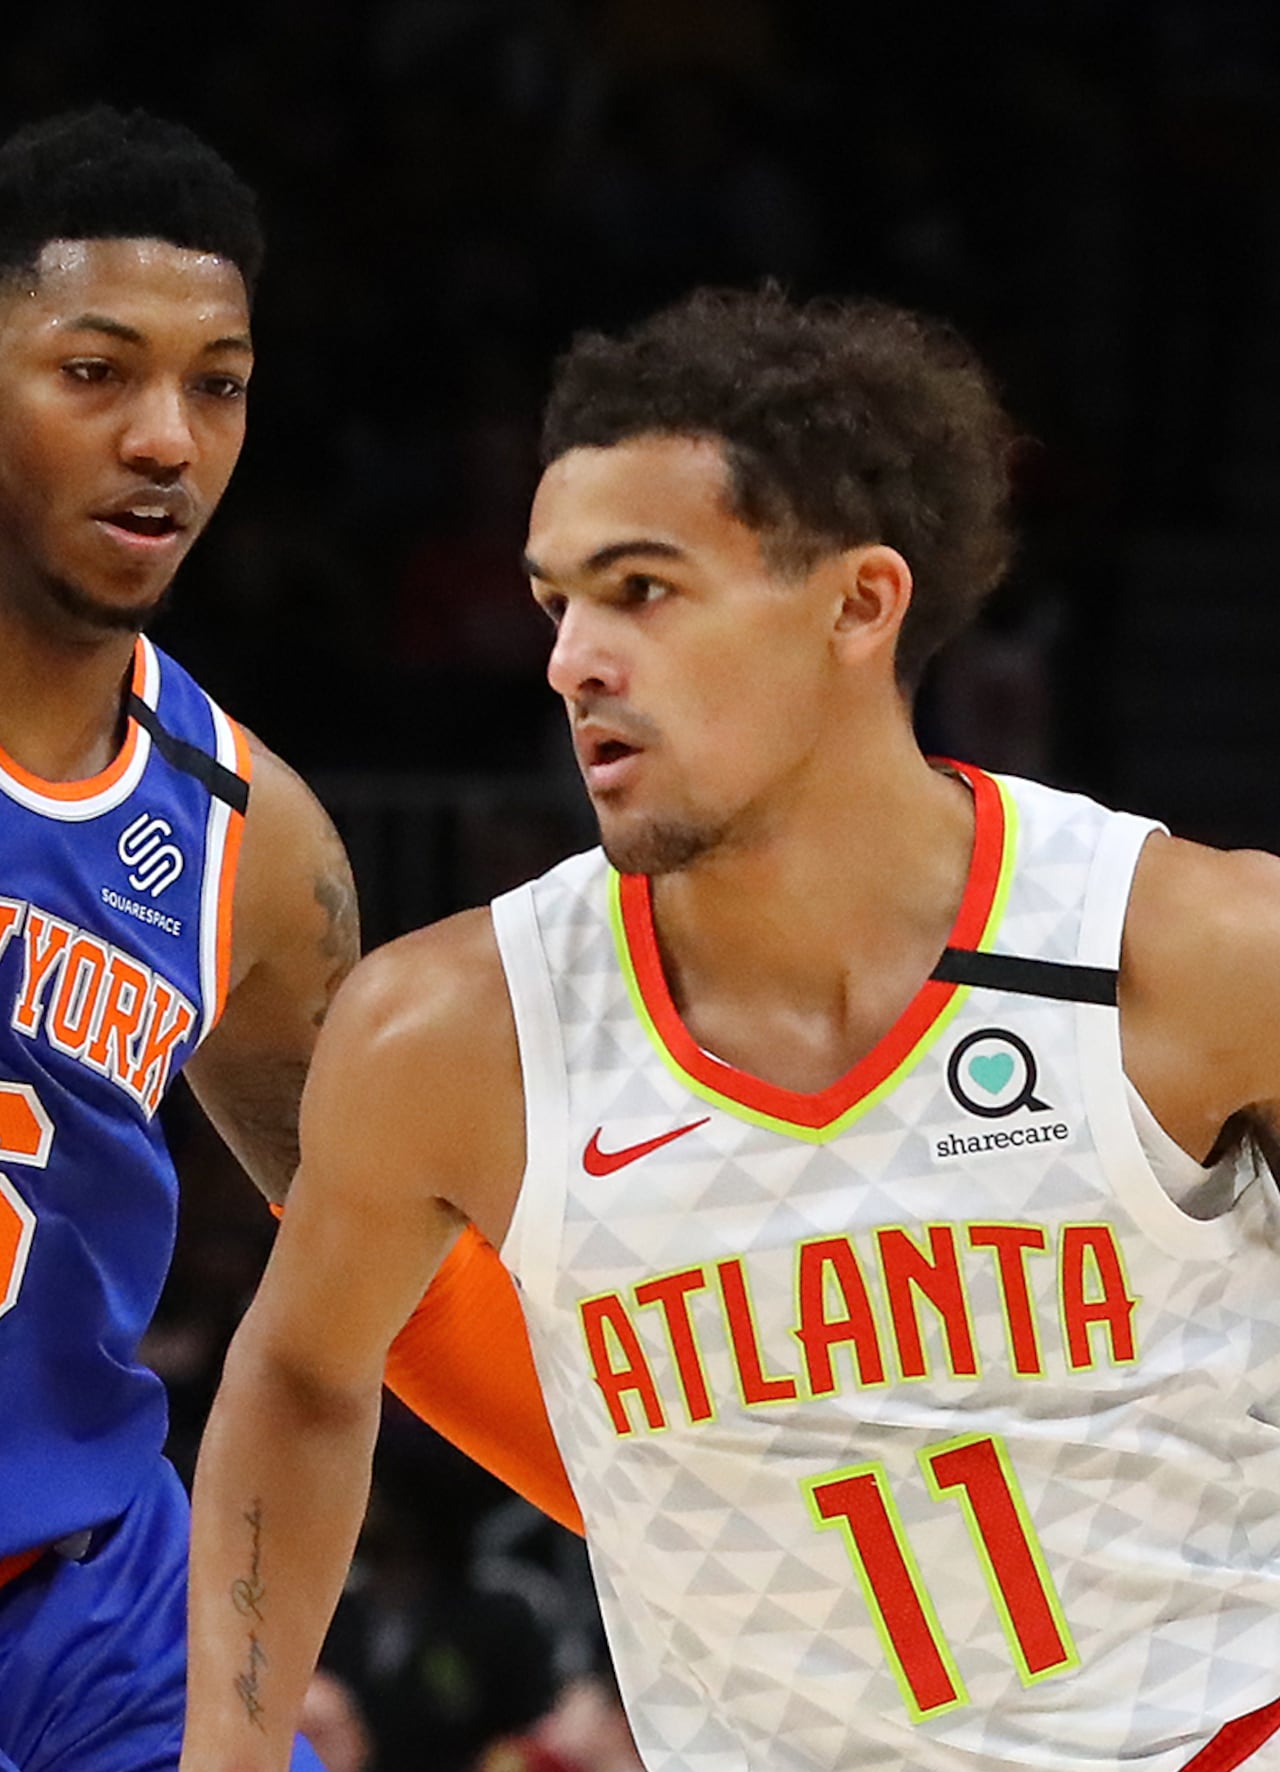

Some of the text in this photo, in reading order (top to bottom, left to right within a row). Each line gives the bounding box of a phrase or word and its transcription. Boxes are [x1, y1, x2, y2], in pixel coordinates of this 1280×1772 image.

[10, 898, 199, 1123] YORK
[100, 887, 182, 937] SQUARESPACE
[936, 1122, 1070, 1158] sharecare
[574, 1219, 1144, 1439] ATLANTA
[798, 1431, 1082, 1724] 11
